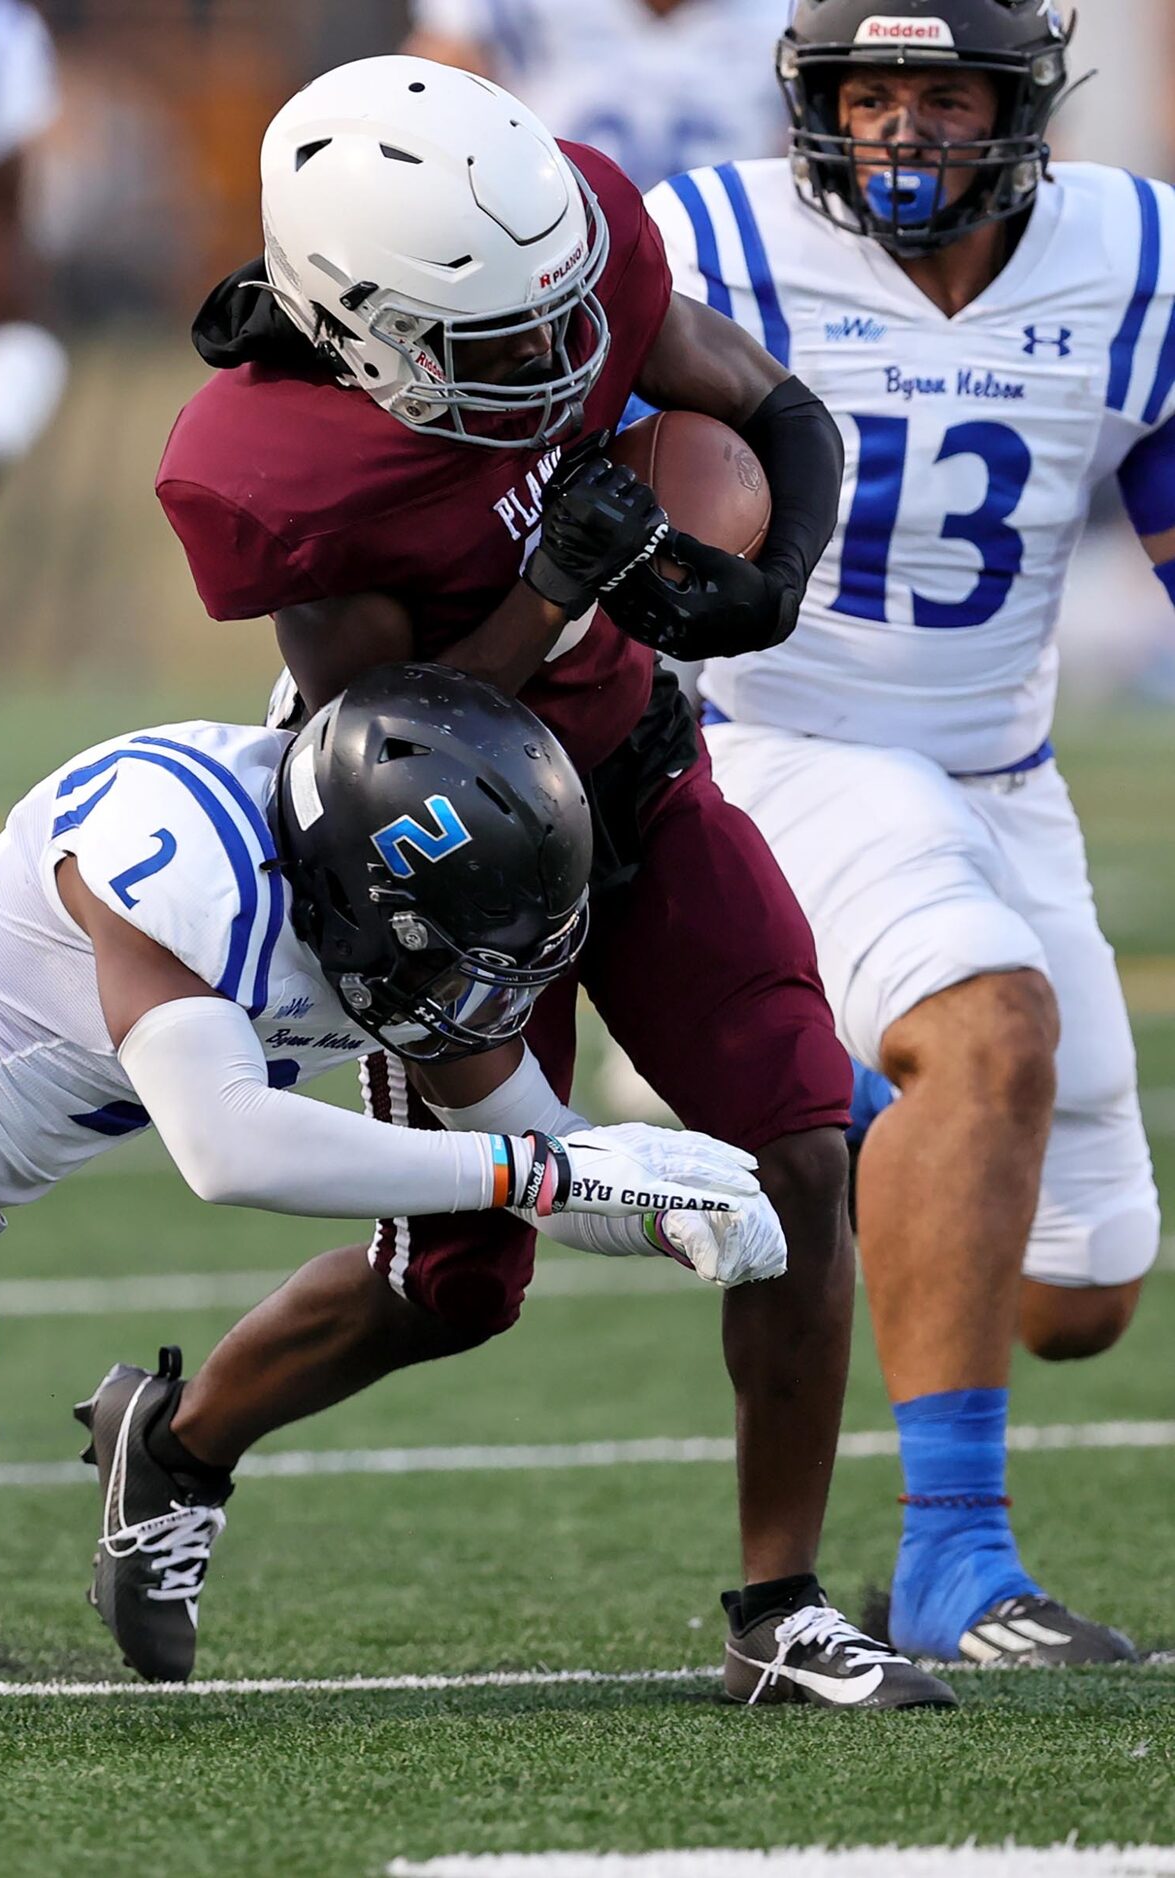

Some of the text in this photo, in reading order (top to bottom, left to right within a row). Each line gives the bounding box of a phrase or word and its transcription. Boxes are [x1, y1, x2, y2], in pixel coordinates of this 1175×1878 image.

[867, 22, 941, 39] Riddell
[552, 247, 582, 283] PLANO
[883, 365, 1026, 401] Byron Nelson
[826, 412, 1032, 628] 13
[369, 793, 473, 880] 2
[107, 826, 178, 911] 2
[264, 1028, 366, 1051] Byron Nelson
[525, 1161, 546, 1208] ootball
[571, 1177, 731, 1212] BYU COUGARS
